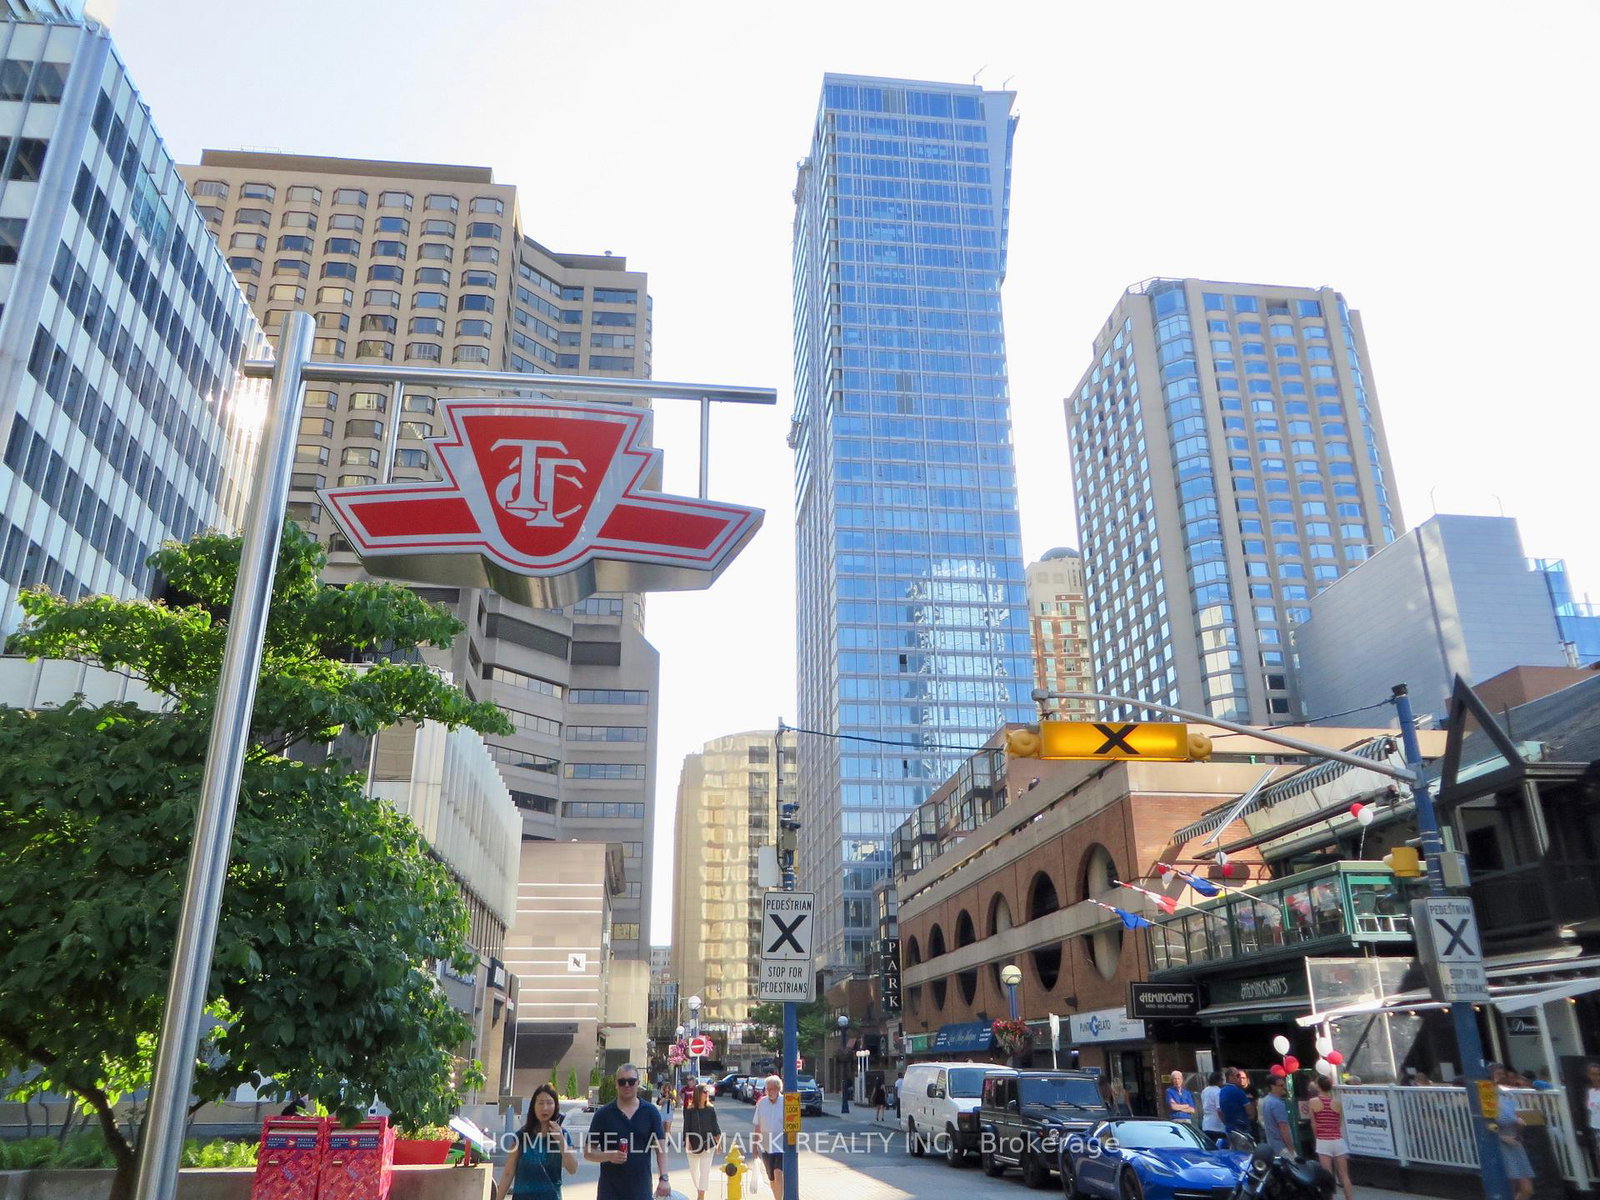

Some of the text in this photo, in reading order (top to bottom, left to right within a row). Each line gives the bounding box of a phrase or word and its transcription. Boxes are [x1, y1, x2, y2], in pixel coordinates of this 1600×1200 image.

[766, 899, 812, 911] PEDESTRIAN
[1429, 904, 1471, 914] PEDESTRIAN
[768, 966, 803, 978] STOP FOR
[887, 941, 899, 1007] PARK
[760, 981, 808, 993] PEDESTRIANS
[1241, 977, 1288, 1000] HEMINGWAY'S
[1139, 992, 1195, 1003] HEMINGWAY'S
